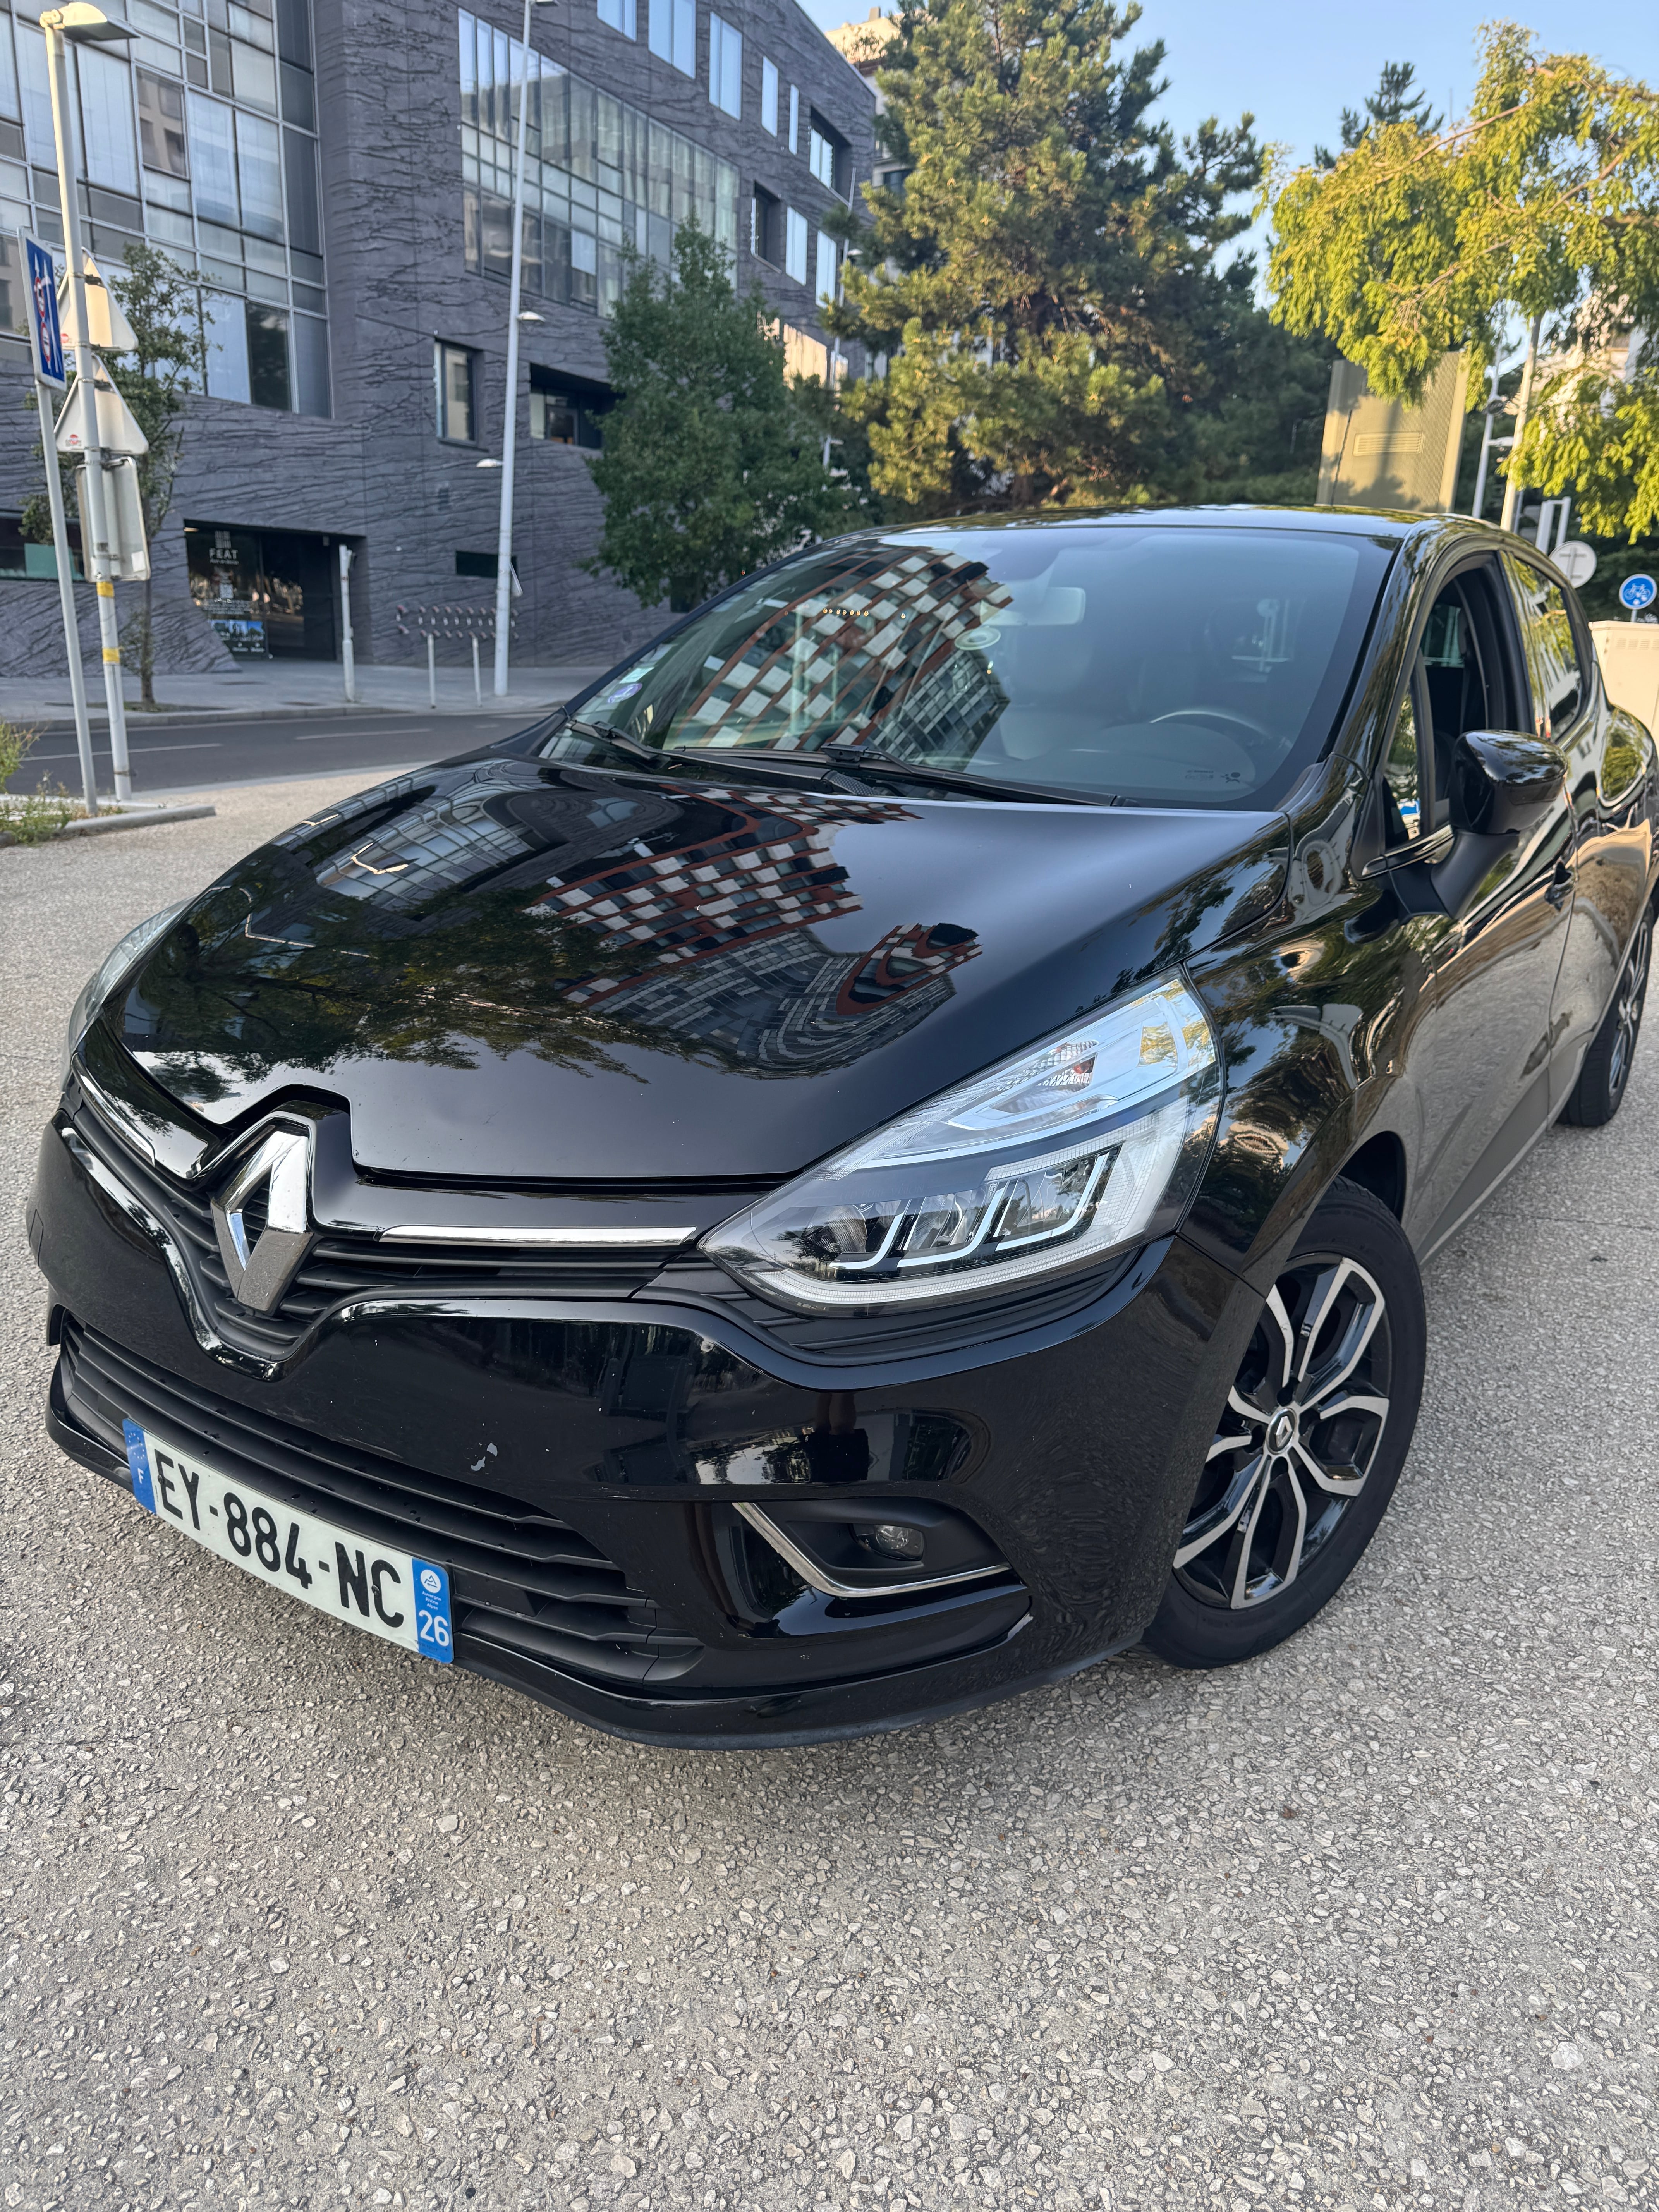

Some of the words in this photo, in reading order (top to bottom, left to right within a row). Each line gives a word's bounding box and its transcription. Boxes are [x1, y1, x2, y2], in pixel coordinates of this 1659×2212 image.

[137, 1468, 144, 1484] F
[154, 1448, 404, 1628] EY-884-NC
[419, 1609, 450, 1647] 26
